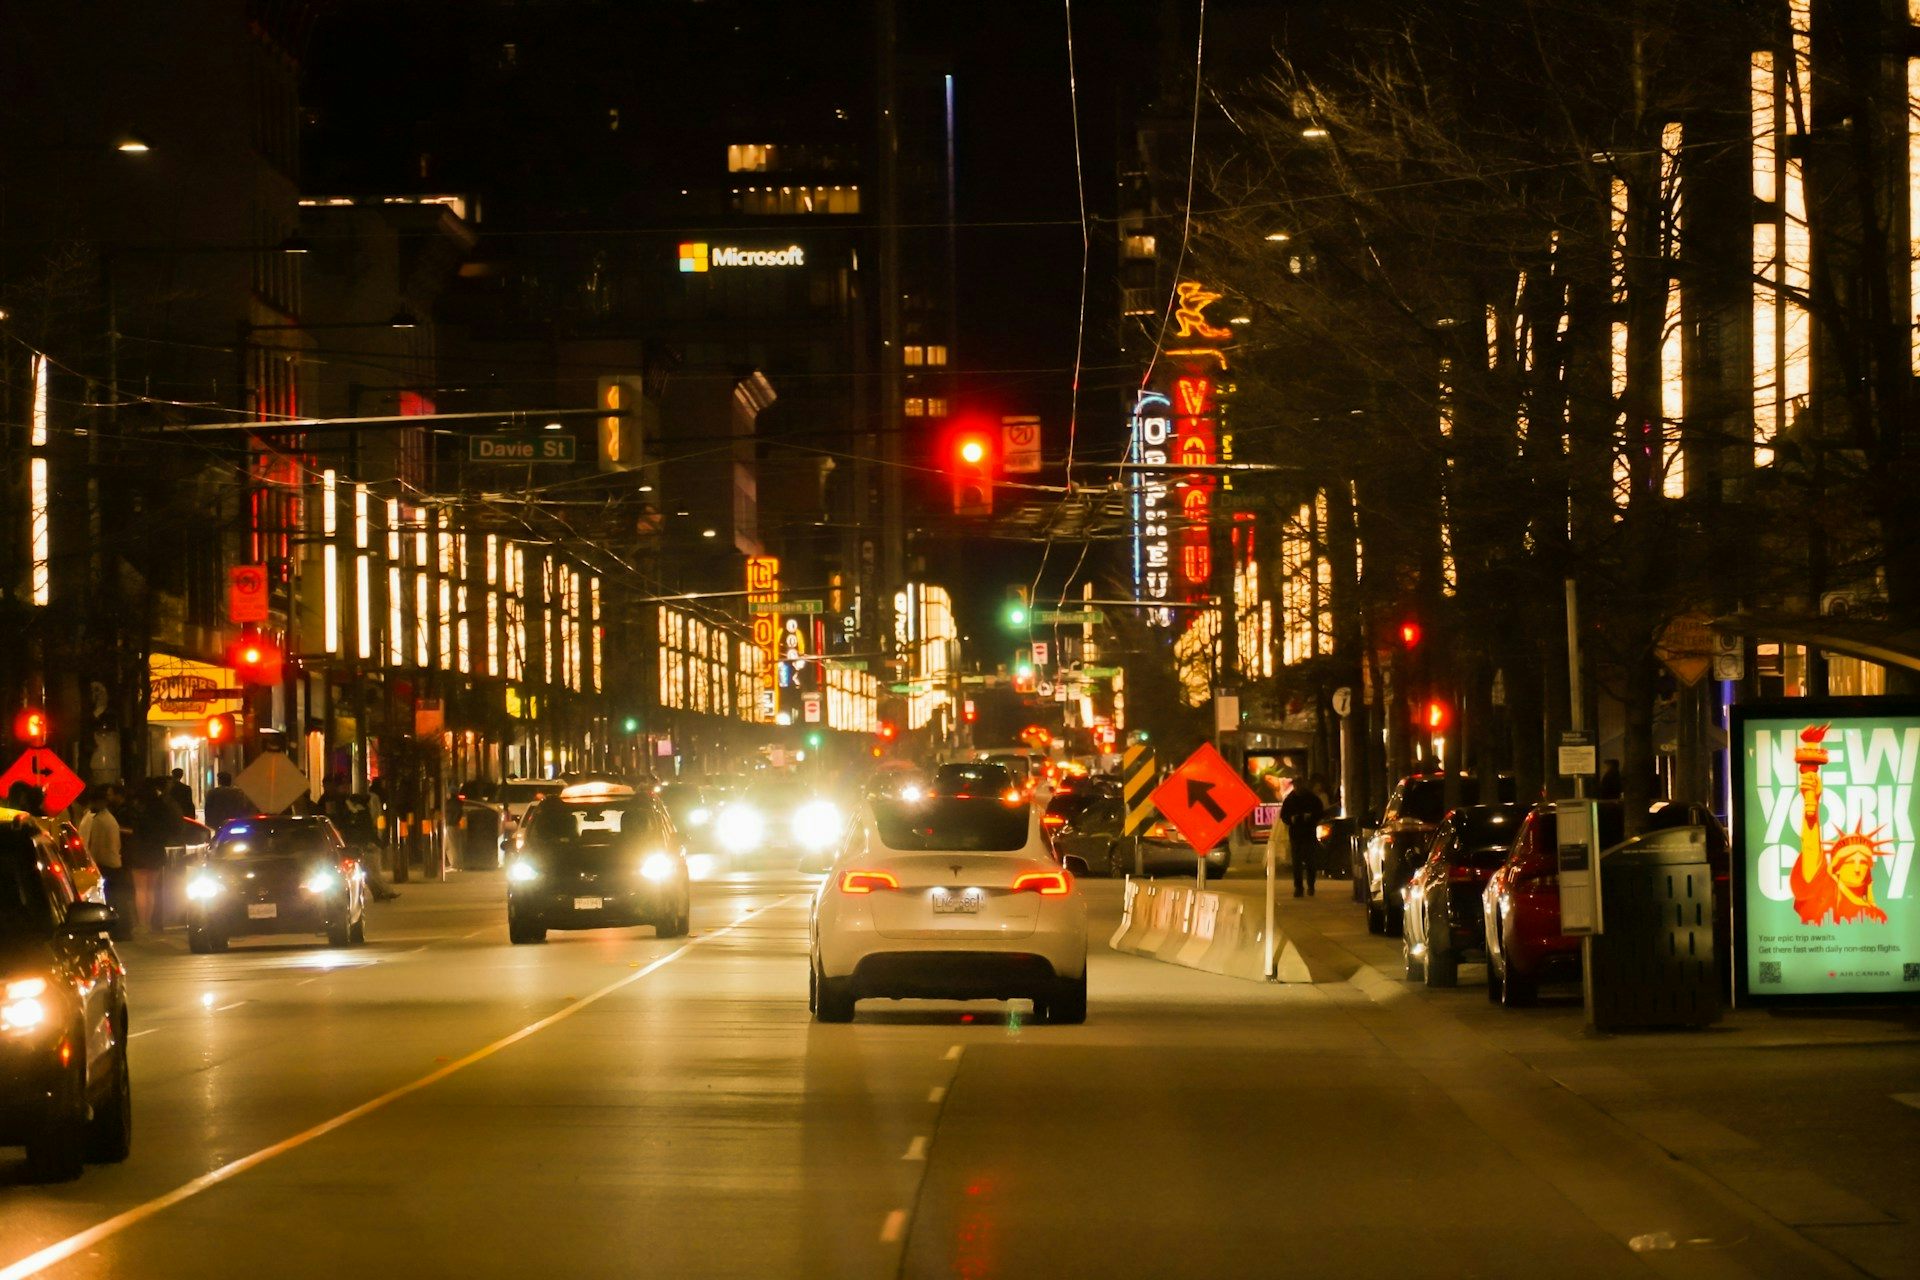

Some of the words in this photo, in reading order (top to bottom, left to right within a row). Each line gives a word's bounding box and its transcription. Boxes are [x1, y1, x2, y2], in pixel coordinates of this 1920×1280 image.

[712, 246, 804, 266] Microsoft
[480, 440, 534, 457] Davie
[543, 440, 565, 457] St
[1178, 380, 1209, 628] VOGU
[1756, 728, 1920, 786] NEW
[1757, 785, 1915, 844] YORK
[1758, 842, 1915, 901] CY
[1759, 946, 1771, 954] Get
[1793, 945, 1807, 953] fast
[1808, 945, 1824, 953] with
[1825, 945, 1843, 954] daily
[1844, 945, 1876, 954] non-stop
[1778, 935, 1794, 943] epic
[1795, 935, 1809, 943] trip
